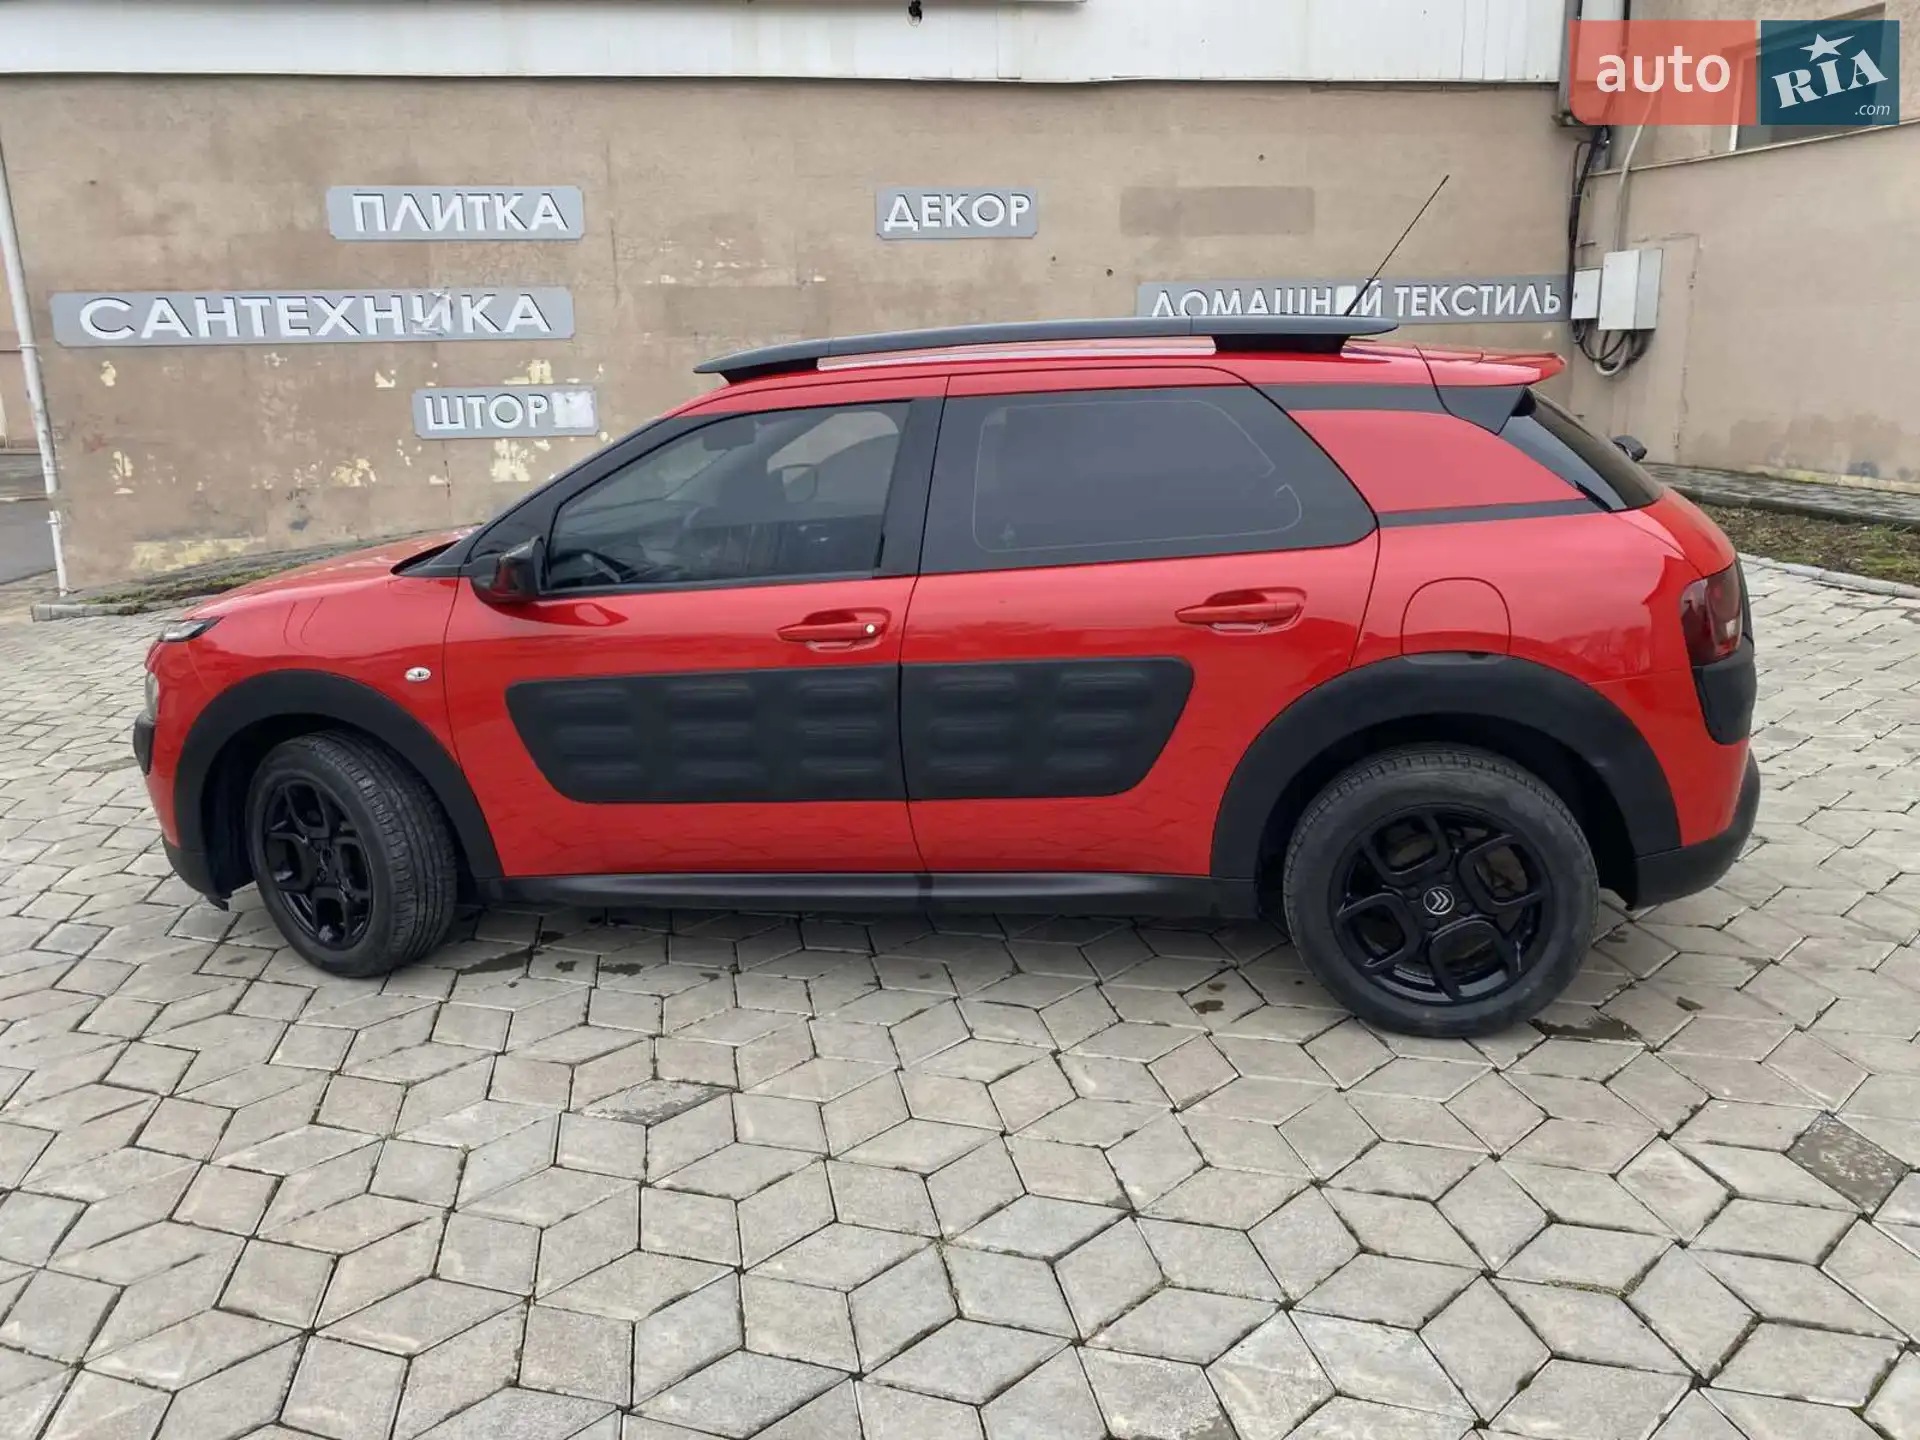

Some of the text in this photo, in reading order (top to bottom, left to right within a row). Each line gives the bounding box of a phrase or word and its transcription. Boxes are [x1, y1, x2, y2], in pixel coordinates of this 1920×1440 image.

[352, 191, 569, 232] ПЛИТКА
[883, 191, 1032, 232] ДЕКОР
[79, 291, 552, 340] САНТЕХНИКА
[1151, 278, 1562, 317] ДОМАШНЙ ТЕКСТИЛЬ
[424, 390, 595, 431] ШТОР
